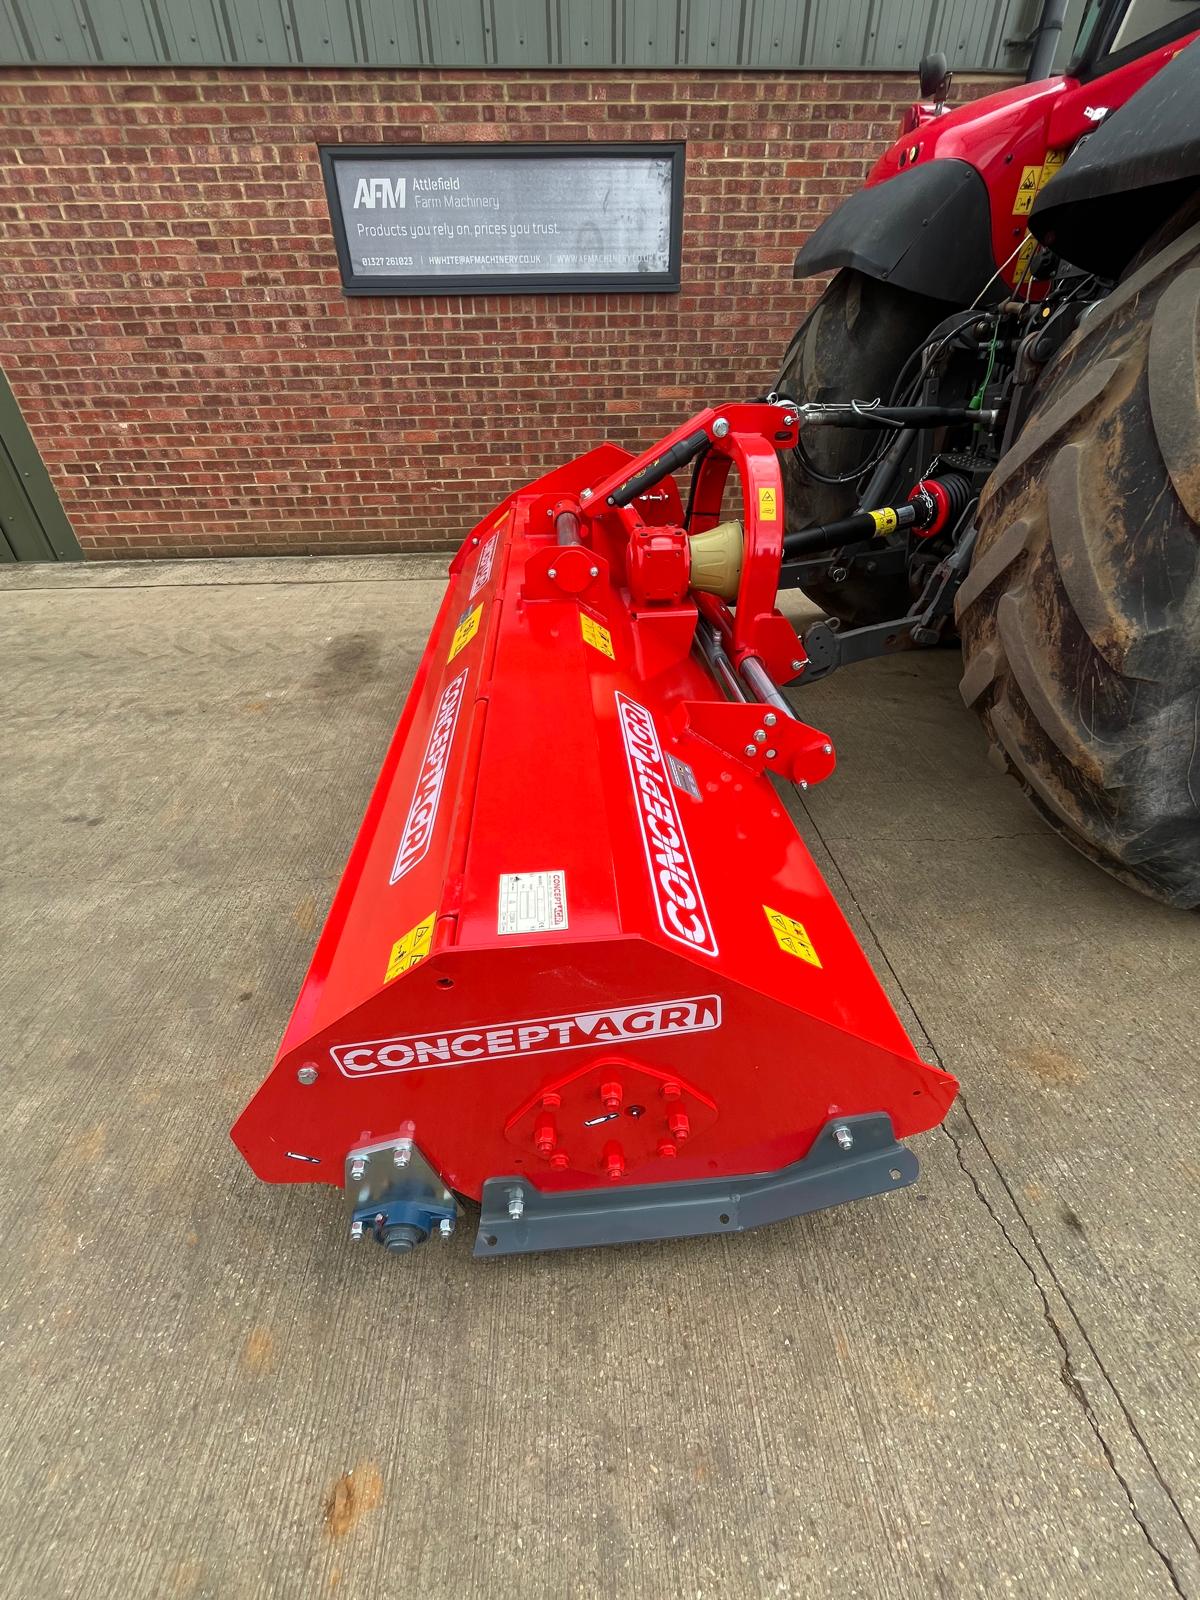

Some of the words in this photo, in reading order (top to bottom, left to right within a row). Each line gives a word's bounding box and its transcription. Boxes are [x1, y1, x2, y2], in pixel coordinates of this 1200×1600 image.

[413, 176, 460, 191] Attlefield
[353, 177, 407, 209] AFM
[414, 194, 441, 209] Farm
[444, 194, 500, 210] Machinery
[357, 223, 408, 238] Products
[411, 224, 431, 239] you
[433, 222, 454, 239] rely
[474, 221, 507, 238] prices
[509, 222, 530, 239] you
[362, 256, 385, 266] 01327
[386, 256, 414, 266] 261023
